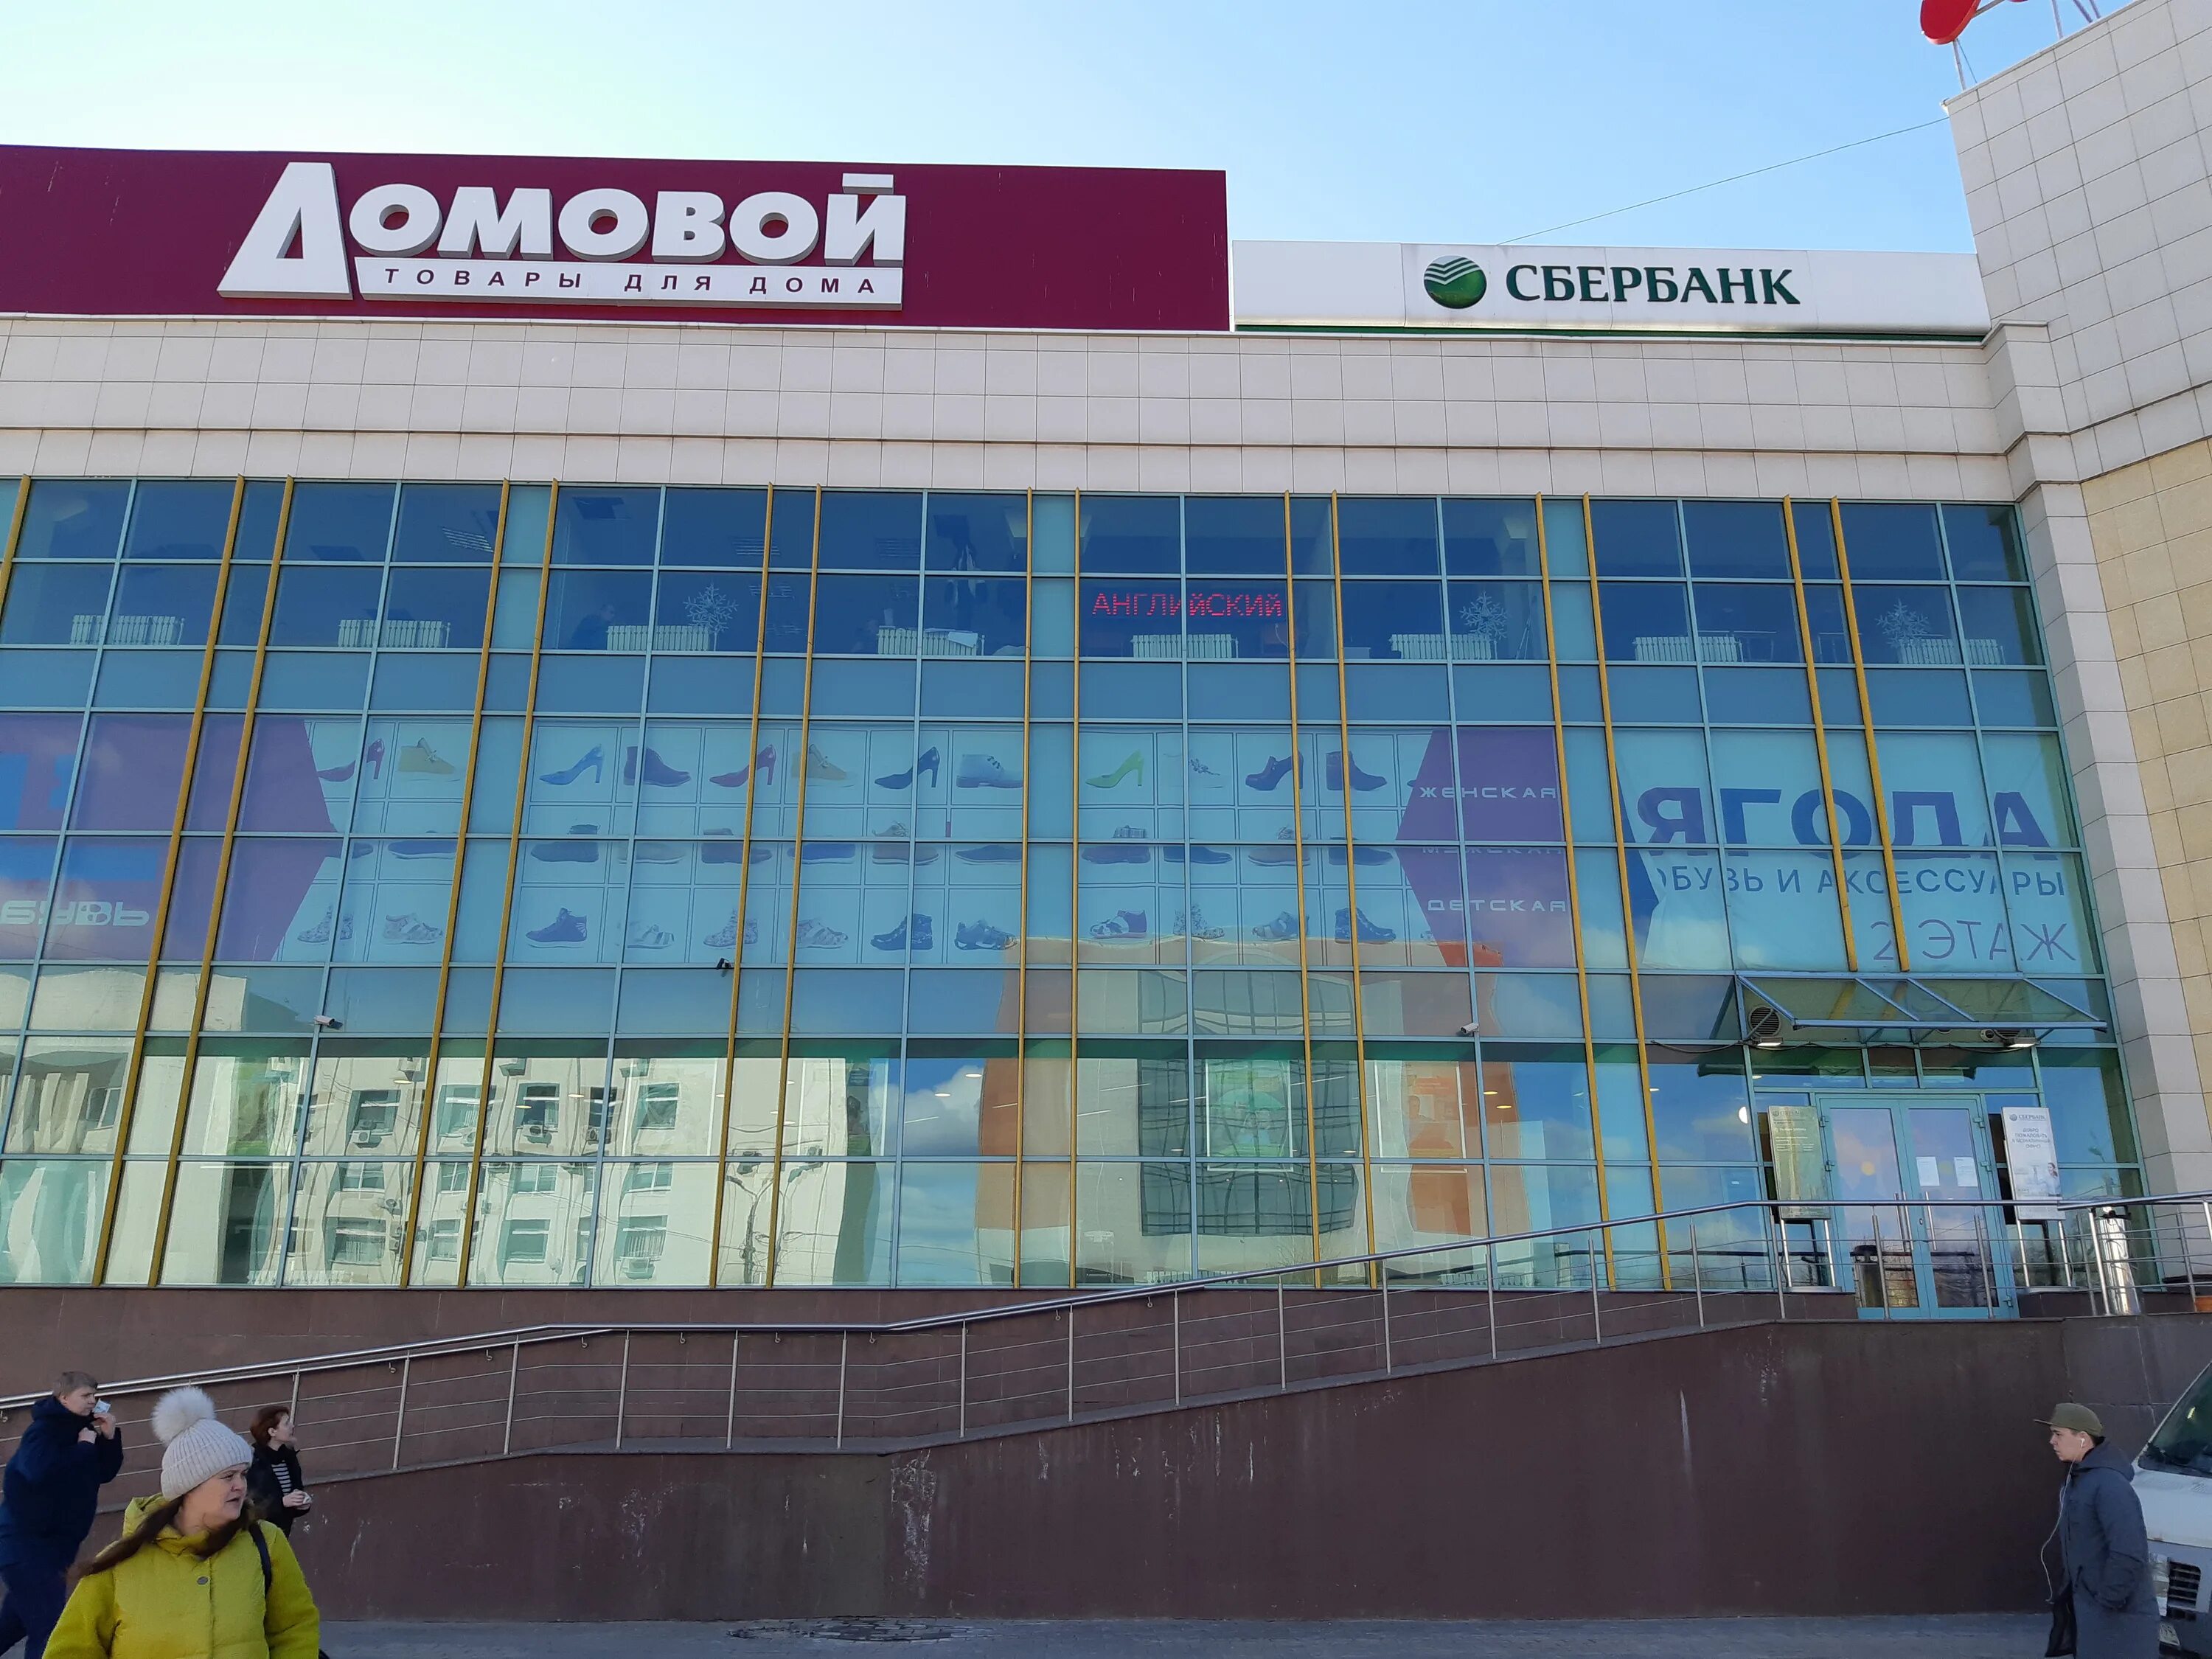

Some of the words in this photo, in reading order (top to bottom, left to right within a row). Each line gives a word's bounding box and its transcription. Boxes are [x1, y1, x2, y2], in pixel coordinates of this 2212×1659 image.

[217, 161, 906, 299] ДОМОВОЙ
[384, 268, 581, 289] ТОВАРЫ
[624, 274, 711, 292] ДЛЯ
[749, 276, 875, 295] ДОМА
[1506, 265, 1801, 305] СБЕРБАНК
[1091, 592, 1282, 617] АНГЛИЙСКИЙ
[1419, 786, 1557, 799] ЖЕНСКАЯ
[1637, 787, 2059, 861] ЯГОДА
[1777, 869, 1801, 894] И
[1427, 899, 1567, 913] ДЕТСКАЯ
[1870, 921, 1896, 961] 2
[1919, 919, 2076, 961] ЭТАЖ
